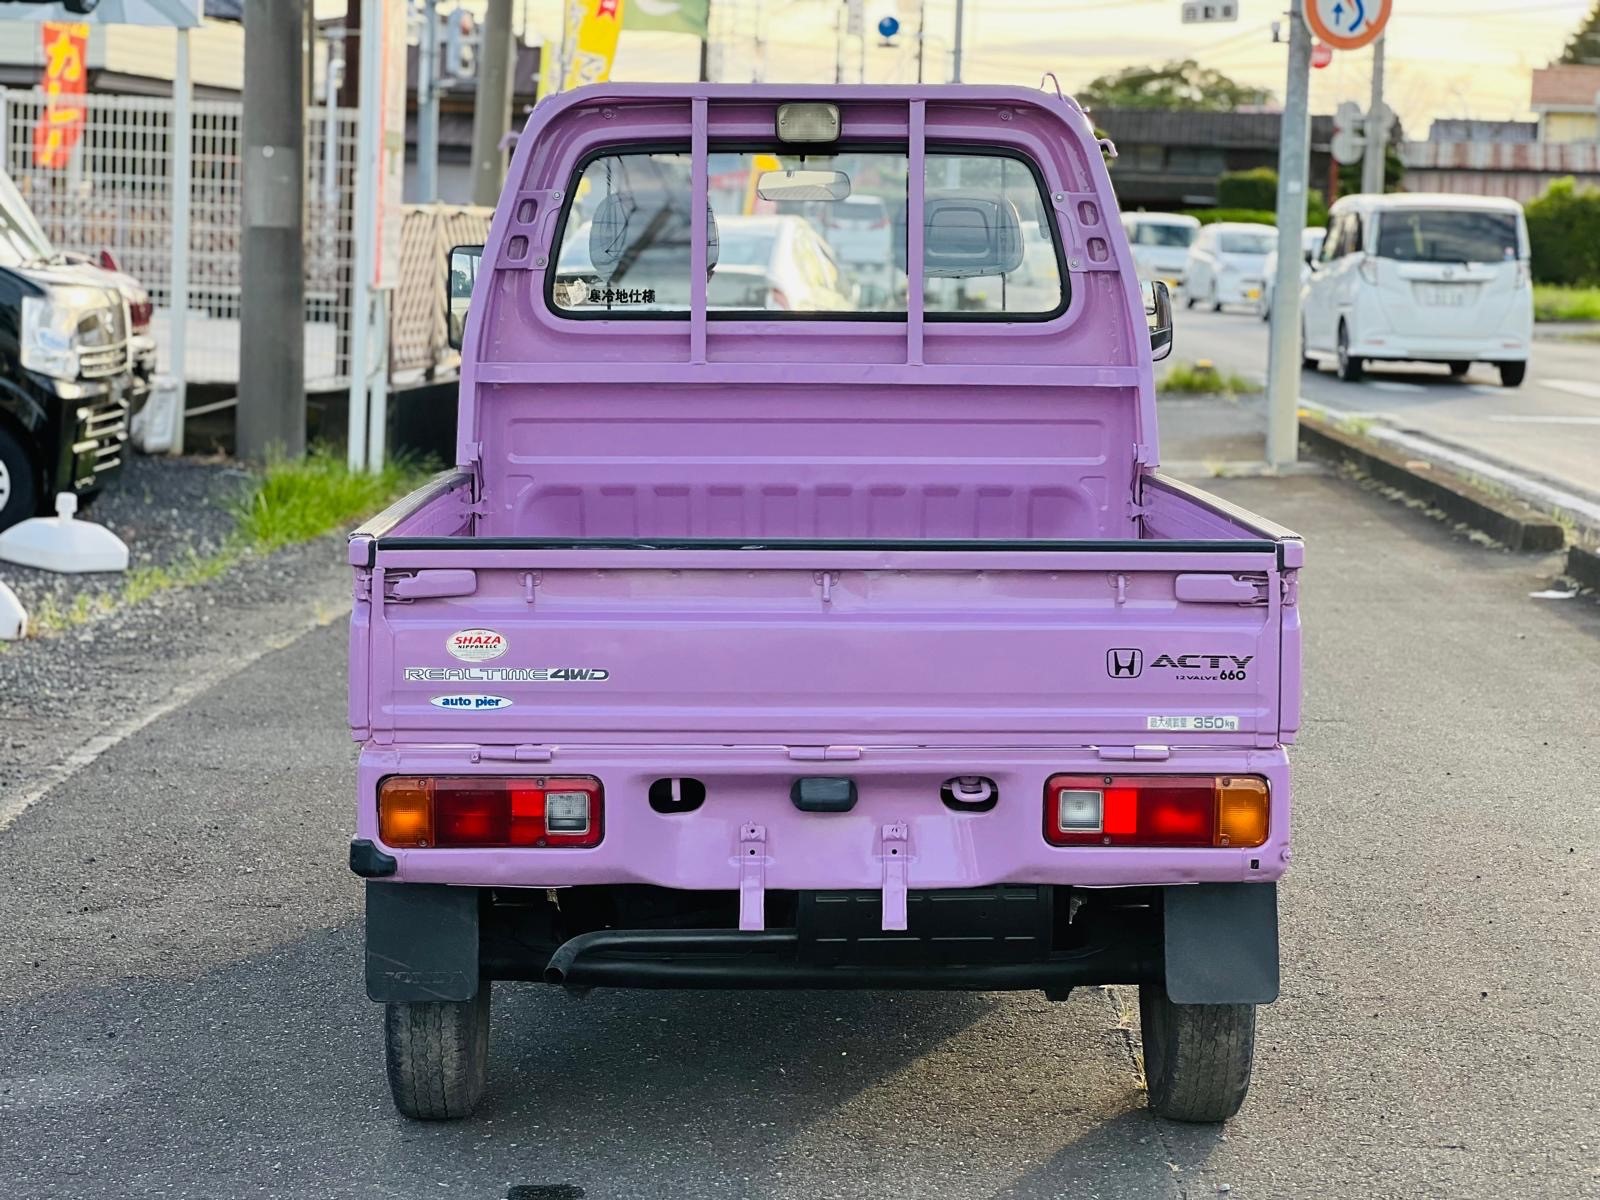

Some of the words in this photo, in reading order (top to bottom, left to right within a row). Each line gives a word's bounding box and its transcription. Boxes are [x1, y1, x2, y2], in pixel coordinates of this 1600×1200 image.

[588, 288, 656, 304] 寒冷地仕様
[453, 636, 502, 645] SHAZA
[1149, 654, 1255, 669] ACTY
[441, 697, 472, 707] auto
[475, 696, 502, 708] pier
